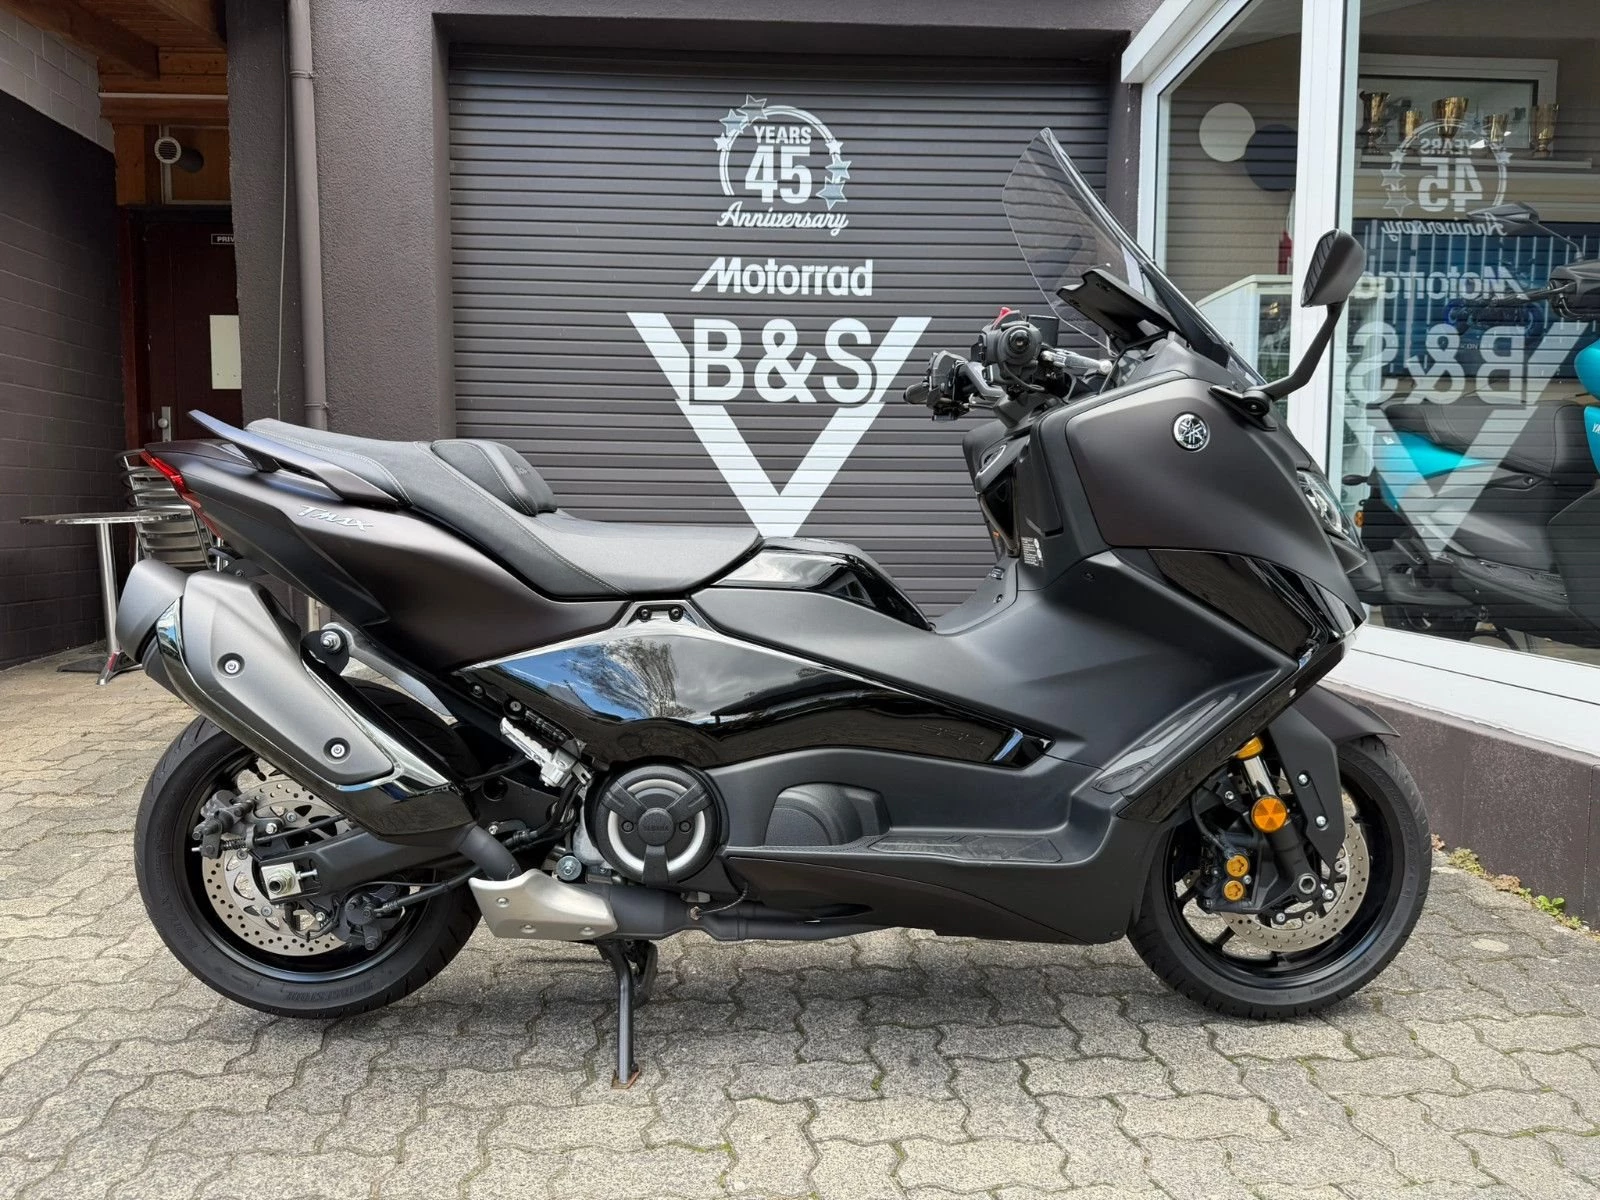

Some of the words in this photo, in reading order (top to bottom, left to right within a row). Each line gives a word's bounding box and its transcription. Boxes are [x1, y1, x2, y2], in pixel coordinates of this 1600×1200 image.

[753, 126, 811, 144] YEARS
[744, 145, 812, 204] 45
[716, 201, 849, 236] Anniversary
[691, 257, 873, 296] Motorrad
[693, 318, 875, 403] B&S
